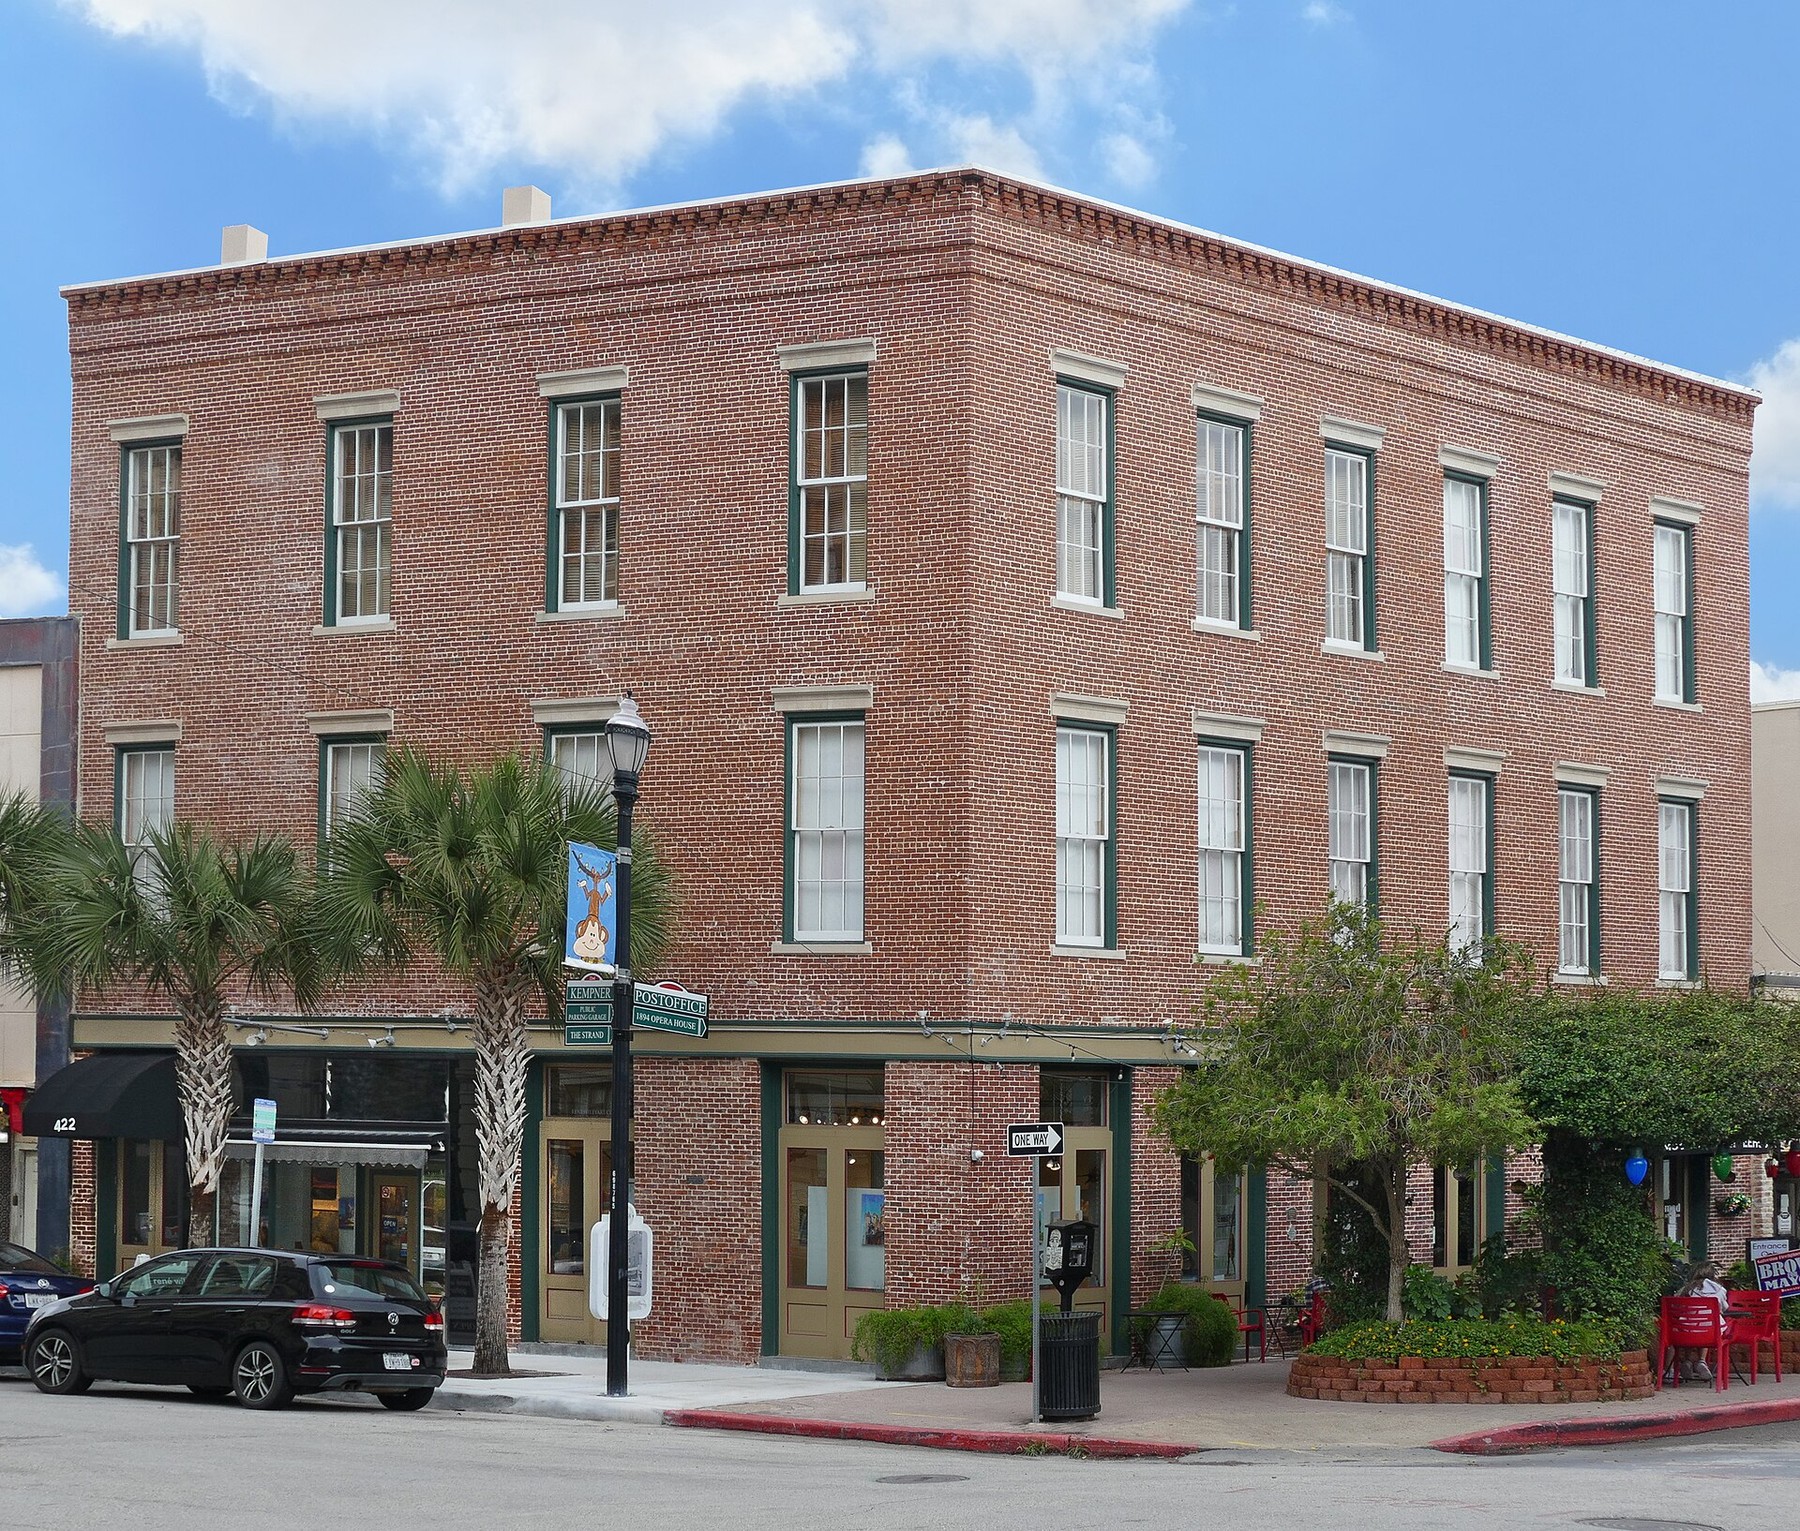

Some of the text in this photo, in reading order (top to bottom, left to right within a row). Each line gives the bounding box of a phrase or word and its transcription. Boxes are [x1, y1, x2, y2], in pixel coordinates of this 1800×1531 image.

[570, 987, 611, 999] KEMPNER
[635, 990, 706, 1014] POSTOFFICE
[568, 1013, 607, 1021] PARKING GARAGE
[636, 1012, 697, 1031] 1894 OPERA HOUSE
[570, 1031, 604, 1039] THE STRAND
[53, 1117, 76, 1132] 422
[1014, 1133, 1049, 1147] ONE WAY
[1764, 1275, 1800, 1291] MAY
